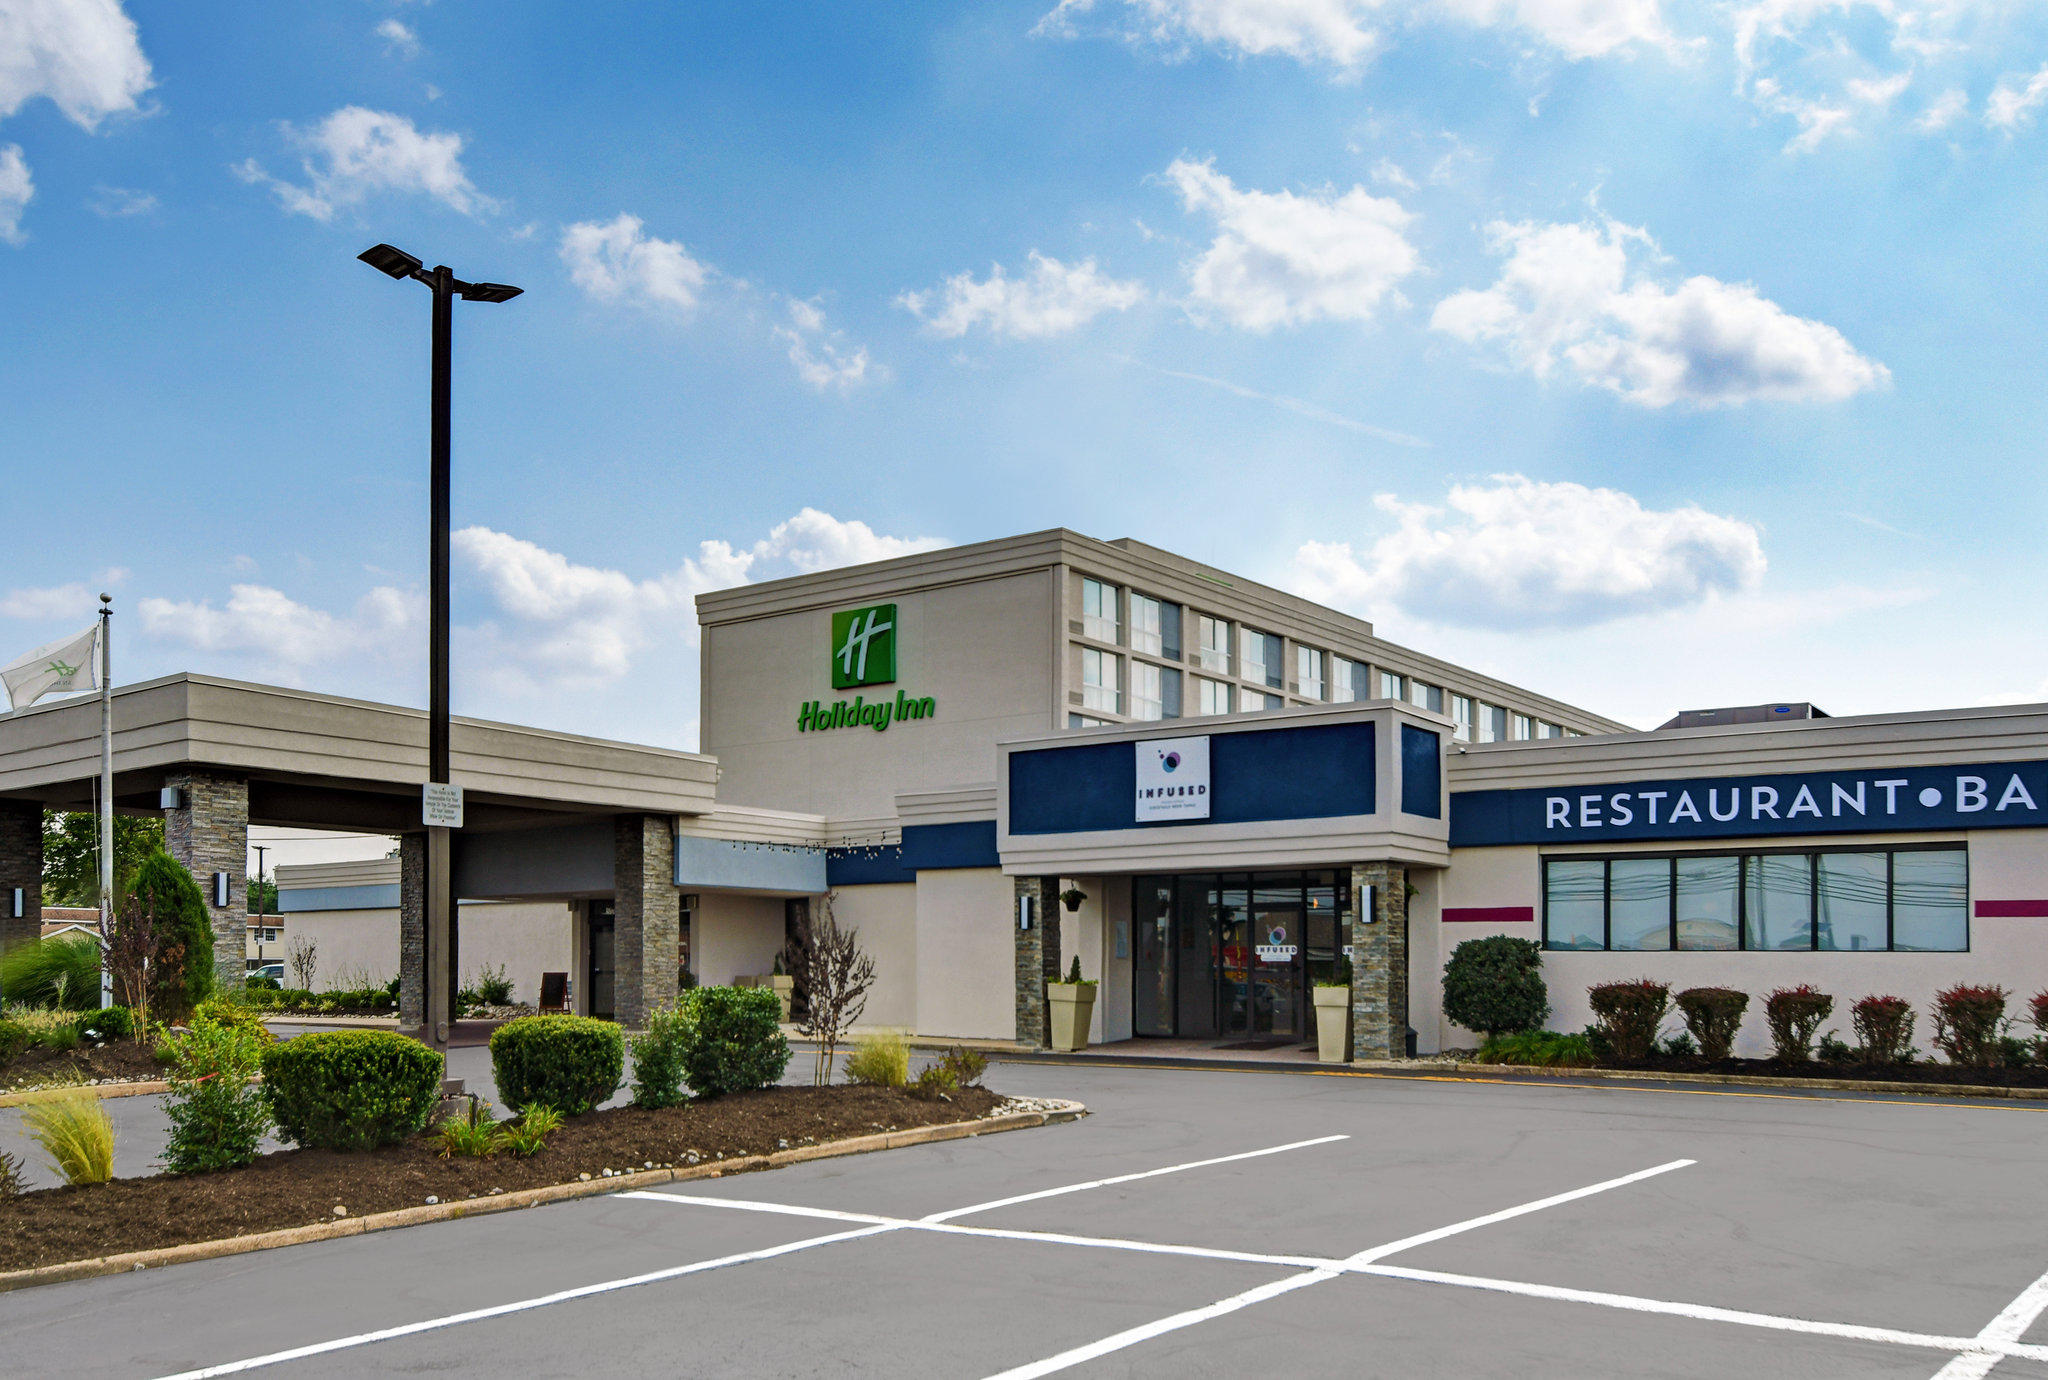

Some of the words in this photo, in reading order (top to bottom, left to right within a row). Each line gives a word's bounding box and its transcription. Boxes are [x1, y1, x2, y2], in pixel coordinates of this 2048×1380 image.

[797, 695, 893, 732] Holiday
[893, 690, 936, 722] Inn
[1139, 785, 1206, 798] INFUSED
[1546, 779, 1908, 829] RESTAURANT
[1956, 773, 2037, 812] BA
